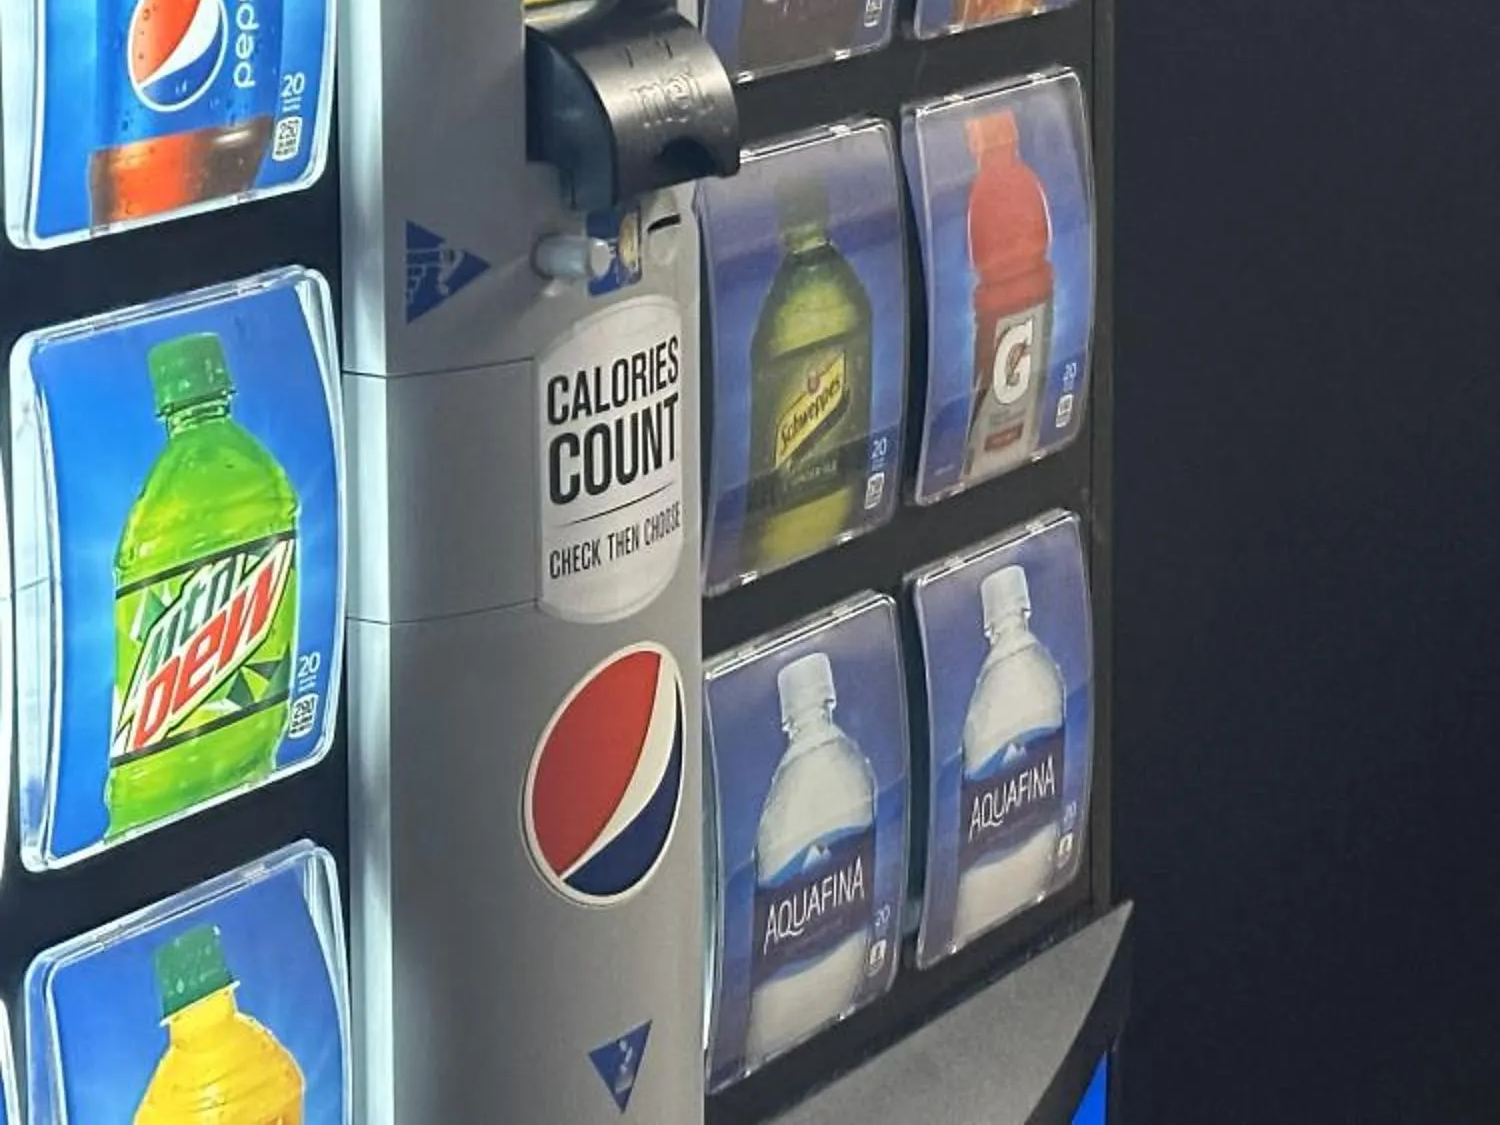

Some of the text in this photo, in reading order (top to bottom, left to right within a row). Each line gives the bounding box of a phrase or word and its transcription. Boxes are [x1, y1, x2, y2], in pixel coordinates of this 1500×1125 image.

[280, 72, 306, 98] 20
[547, 334, 680, 426] CALORIES
[993, 317, 1034, 405] G
[549, 393, 679, 506] COUNT
[871, 436, 888, 460] 20
[549, 501, 682, 580] CHECK THEN CHOOSE
[297, 651, 321, 678] 20
[968, 756, 1055, 843] AQUAFINA
[763, 854, 866, 956] AQUAFINA
